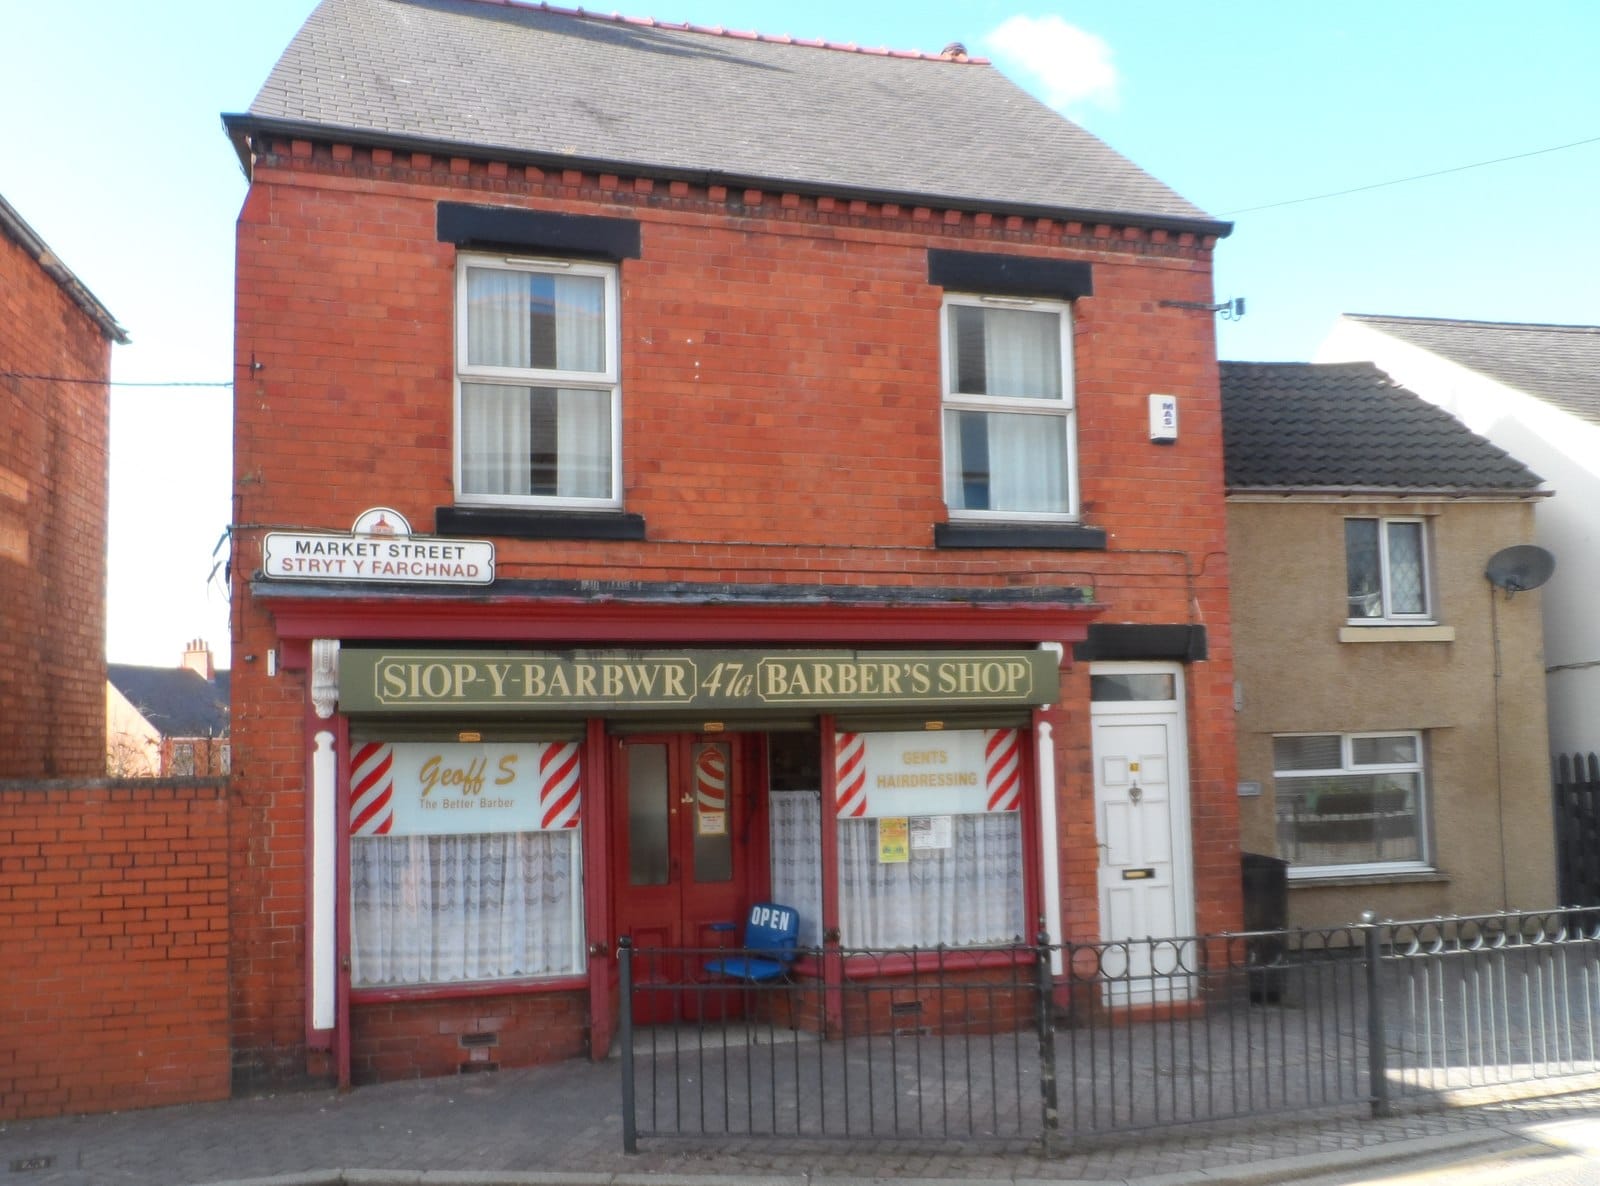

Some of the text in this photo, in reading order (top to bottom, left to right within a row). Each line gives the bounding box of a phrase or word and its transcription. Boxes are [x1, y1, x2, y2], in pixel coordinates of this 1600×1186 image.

[295, 540, 465, 561] MARKET STREET
[281, 557, 479, 578] STRYT Y FARCHNAD
[701, 662, 753, 697] 47a
[765, 662, 932, 696] BARBER'S
[938, 662, 1026, 693] SHOP
[902, 750, 948, 765] GENTS
[419, 753, 518, 797] Geoff S
[876, 772, 978, 789] HAIRDRESSING
[420, 799, 515, 809] The Better Barber
[751, 906, 790, 931] OPEN
